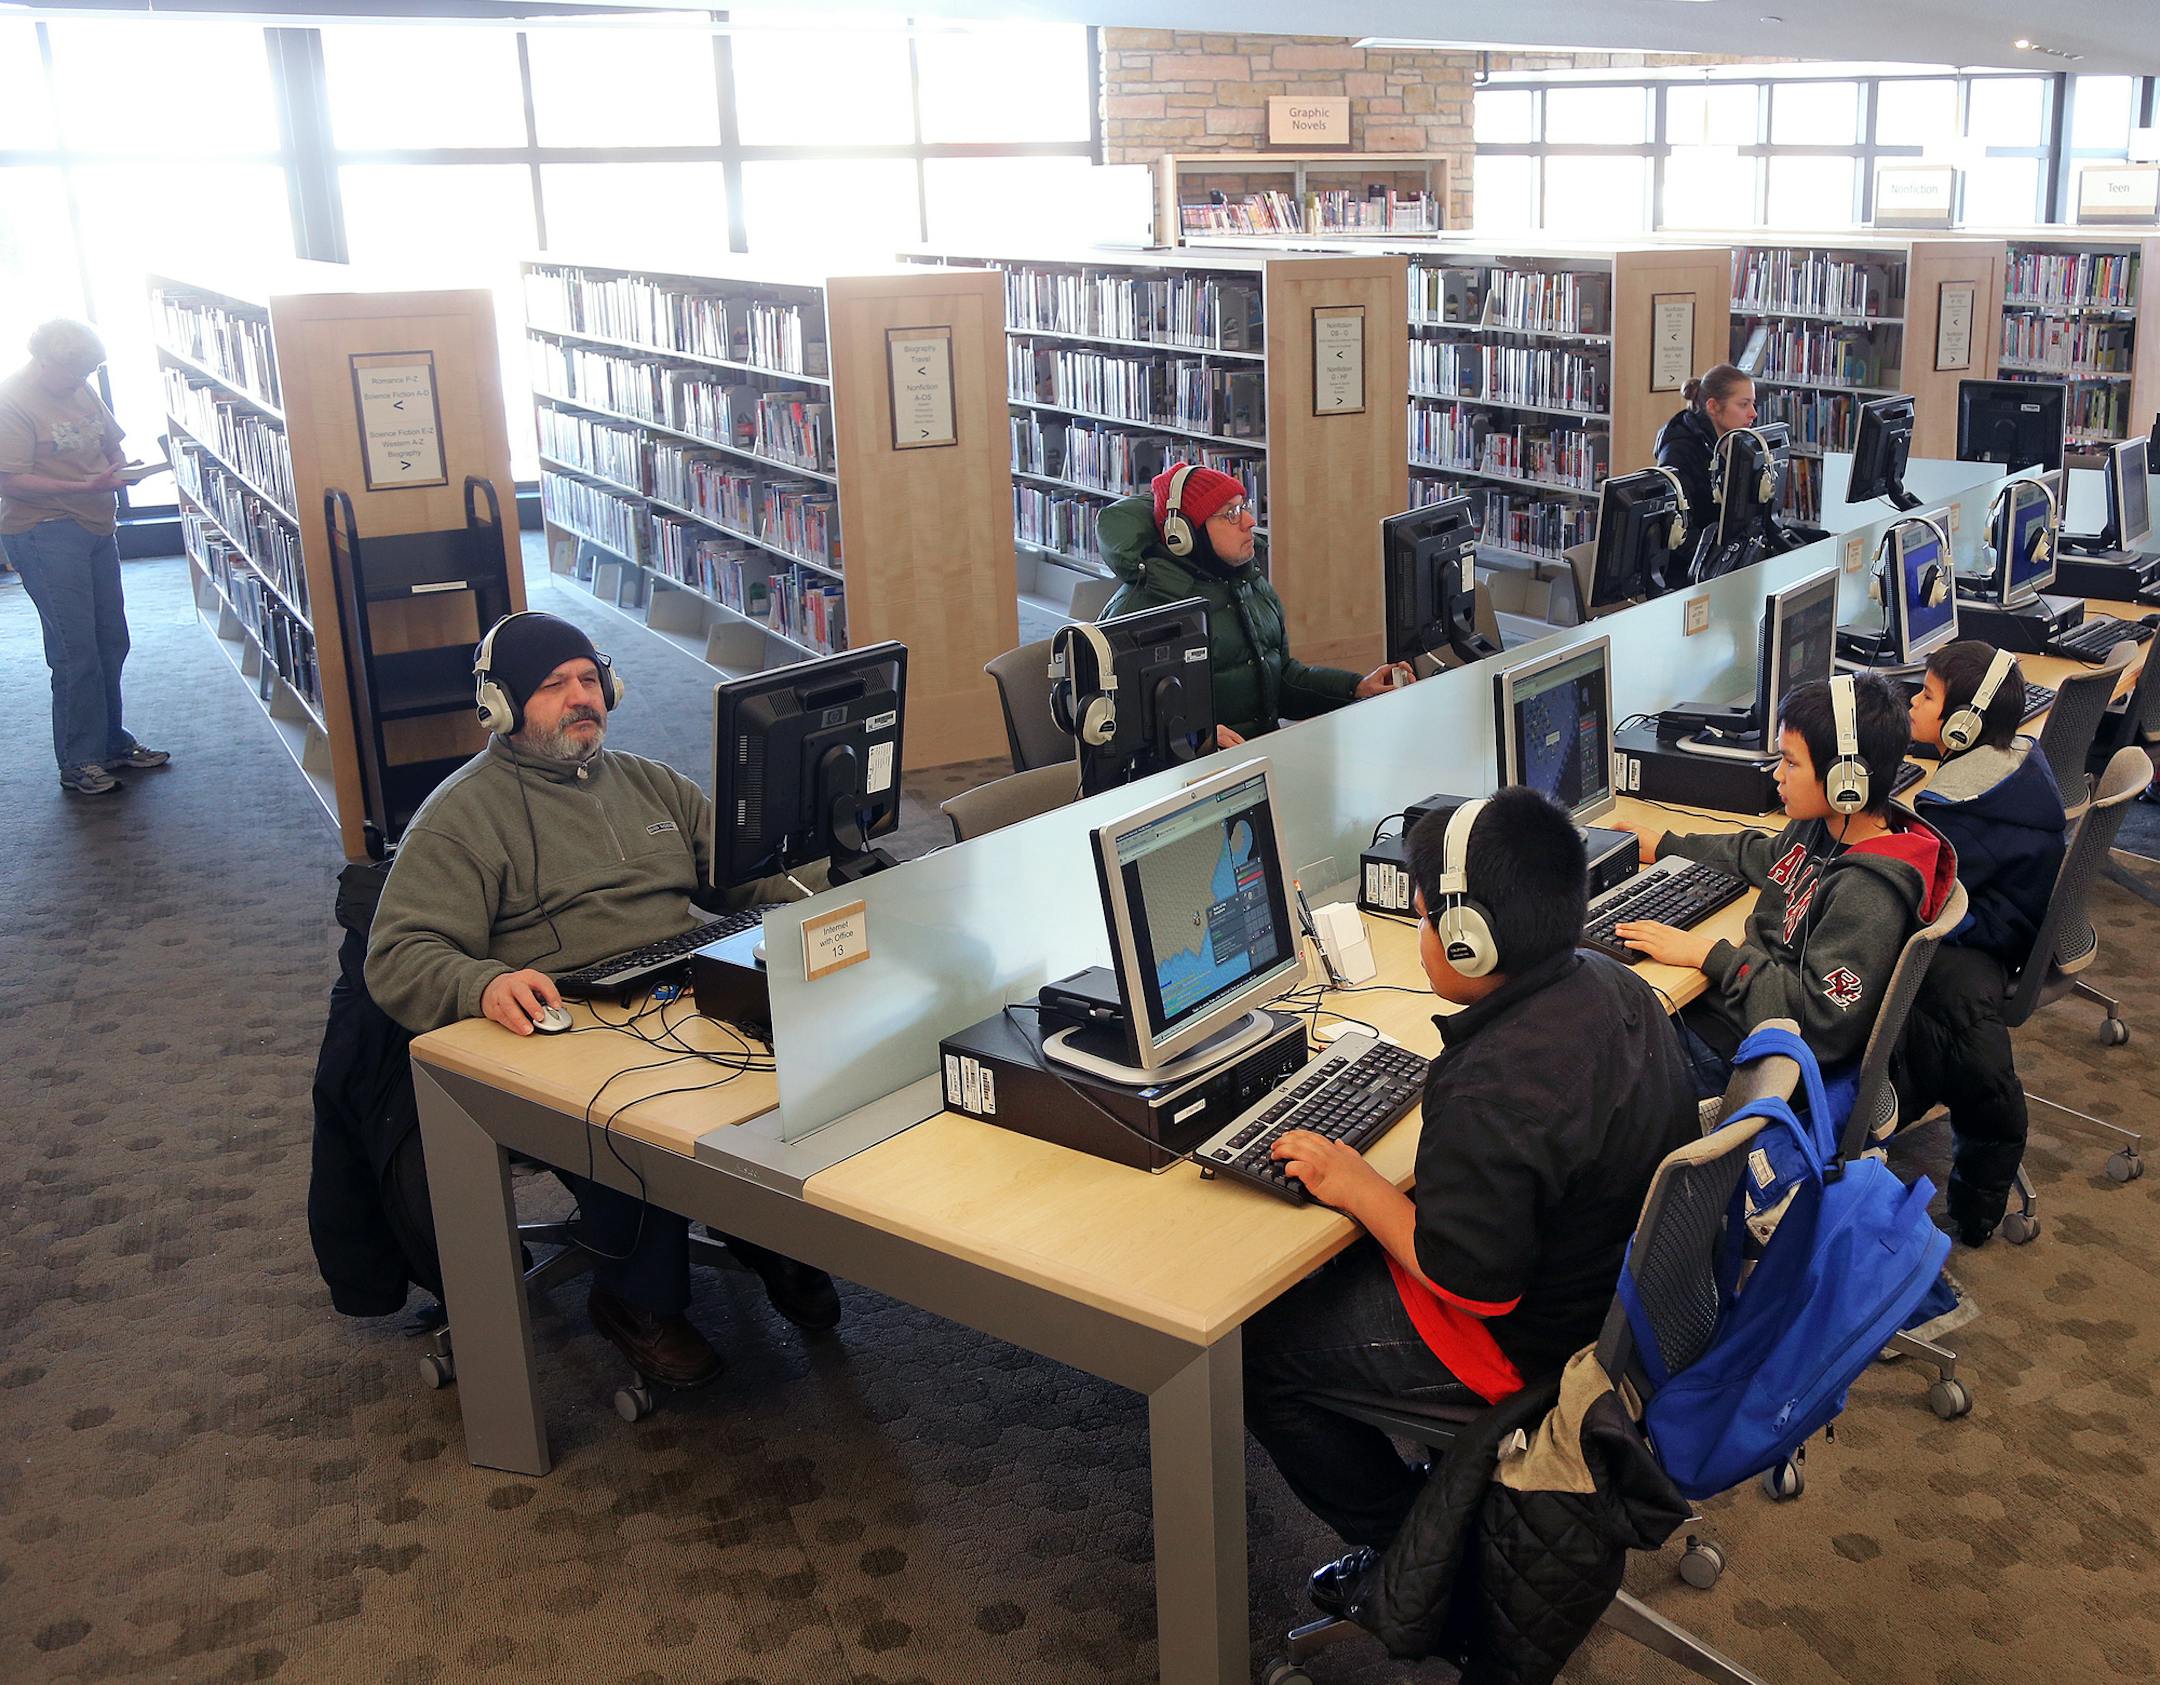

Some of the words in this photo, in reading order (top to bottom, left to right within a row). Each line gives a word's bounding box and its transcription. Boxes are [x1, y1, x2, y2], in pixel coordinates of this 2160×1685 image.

[1289, 107, 1329, 119] Graphic
[1292, 120, 1327, 130] Novels
[1891, 184, 1938, 194] Nonfiction
[2108, 183, 2130, 193] Teen
[904, 345, 936, 353] Biography
[371, 377, 403, 385] Romance
[392, 391, 415, 399] Fiction
[388, 450, 421, 458] Biography
[823, 920, 849, 936] Internet
[819, 937, 834, 947] with
[834, 930, 854, 942] Office
[832, 944, 844, 957] 13
